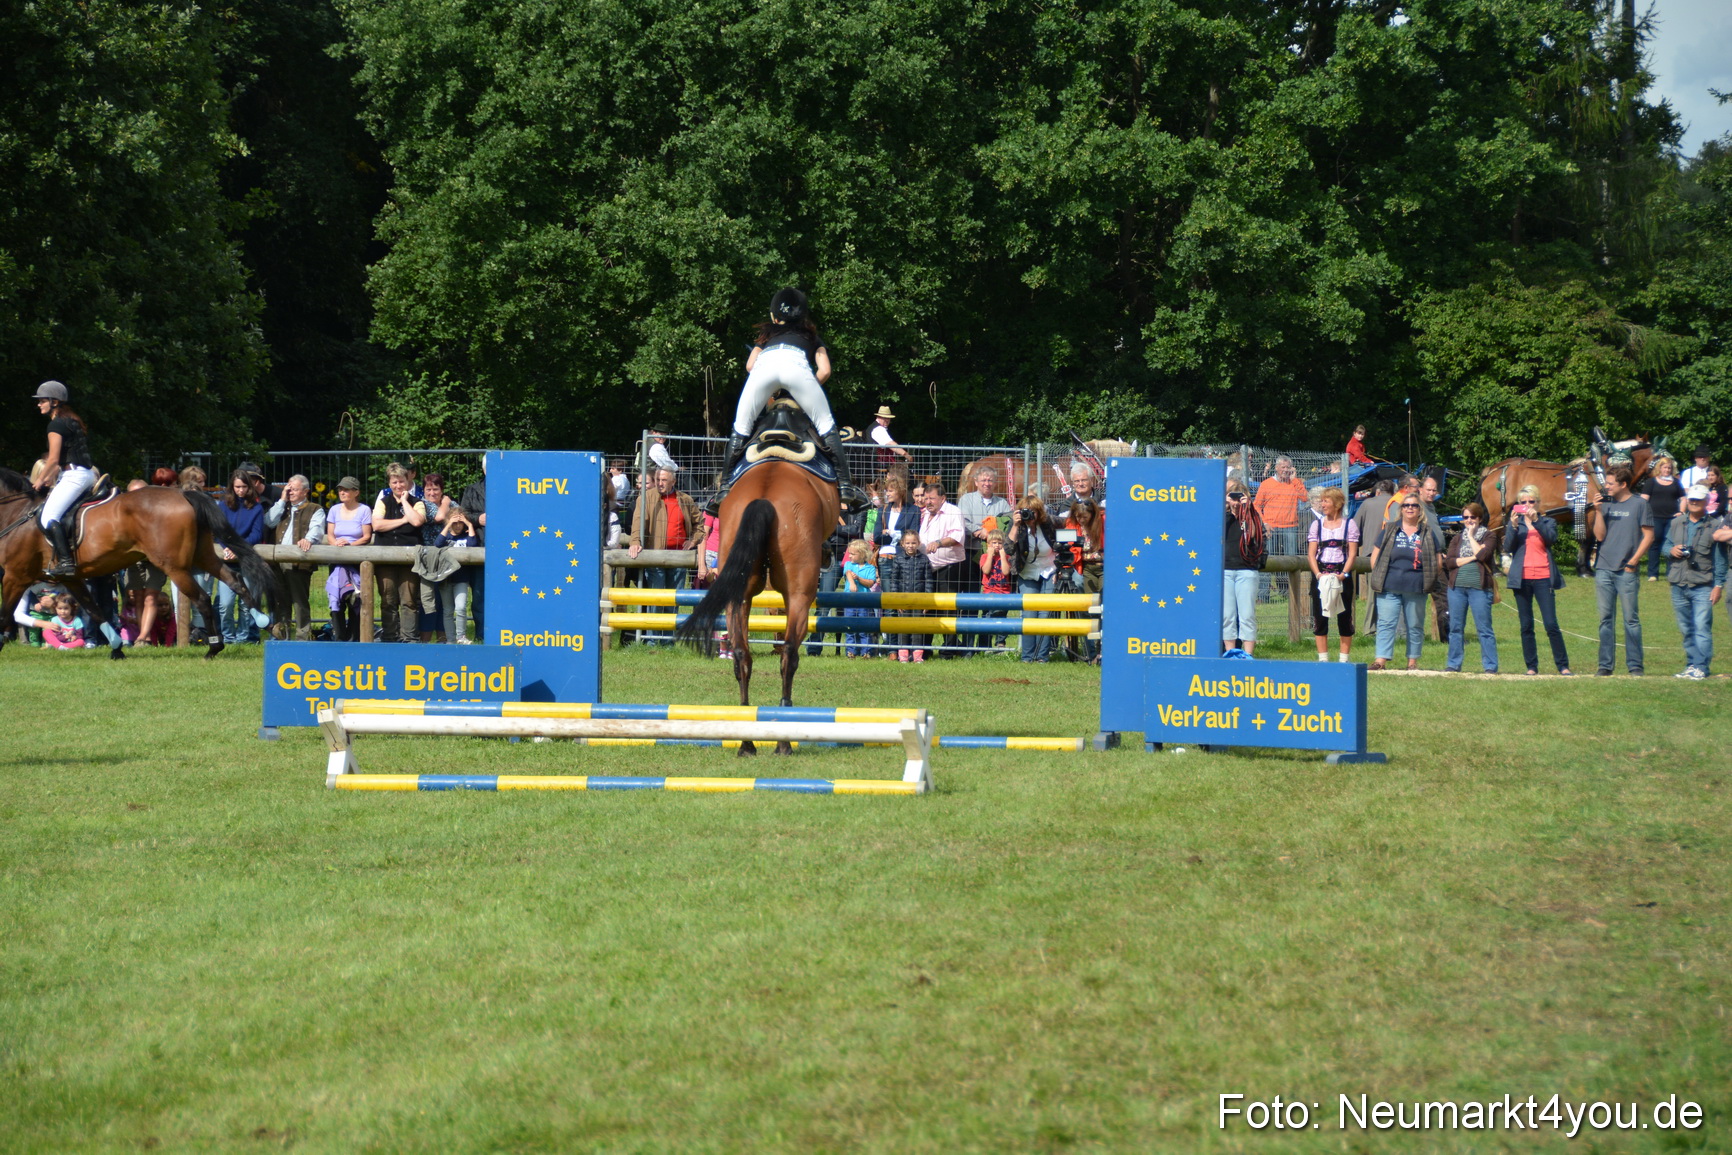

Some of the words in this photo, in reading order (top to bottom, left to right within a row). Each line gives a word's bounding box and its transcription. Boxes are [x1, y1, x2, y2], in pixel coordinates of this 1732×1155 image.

[1129, 484, 1197, 502] Gestüt
[500, 629, 584, 651] Berching
[1127, 637, 1196, 656] Breindl
[276, 662, 388, 691] Gestüt
[404, 664, 515, 692] Breindl
[1187, 674, 1311, 706] Ausbildung
[1157, 703, 1241, 729] Verkauf
[1251, 713, 1267, 731] +
[1277, 704, 1343, 734] Zucht
